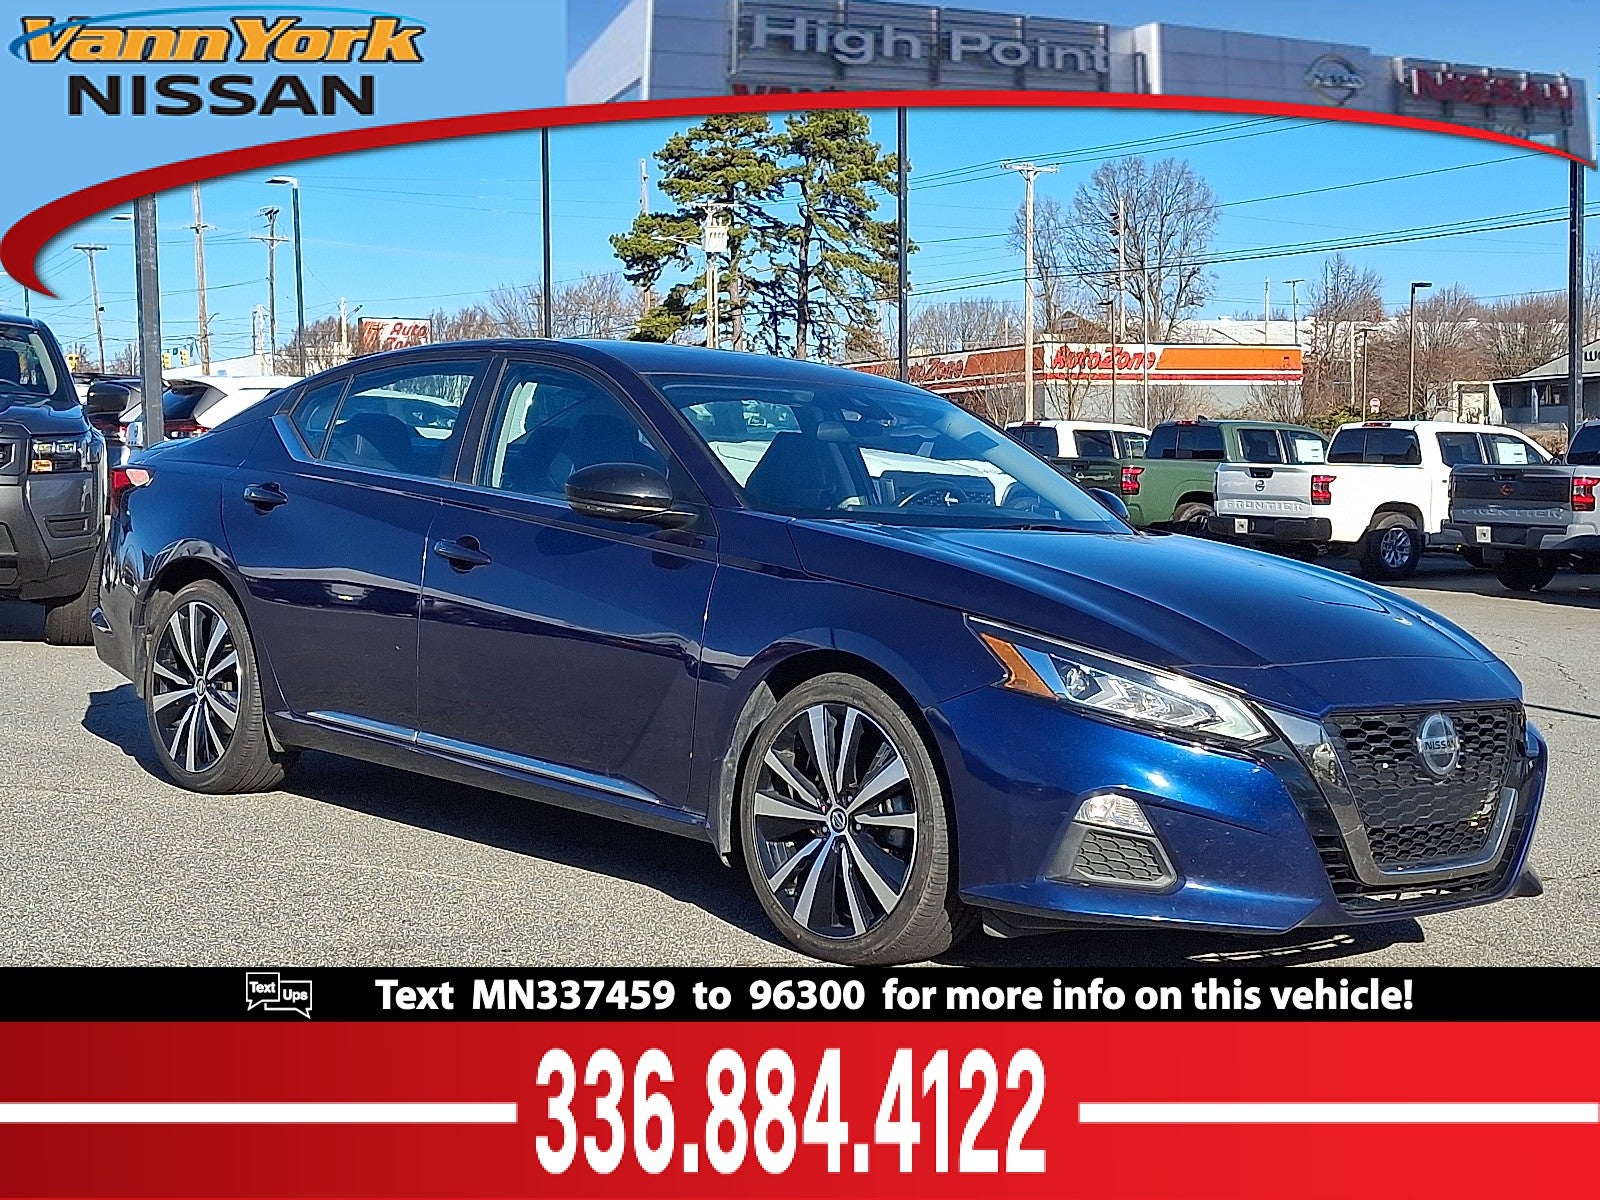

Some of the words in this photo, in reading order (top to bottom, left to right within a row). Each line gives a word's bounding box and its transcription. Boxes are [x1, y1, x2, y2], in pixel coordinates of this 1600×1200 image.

[389, 322, 428, 336] Auto
[1226, 500, 1303, 512] FRONTIER
[1424, 740, 1457, 750] NISSAN
